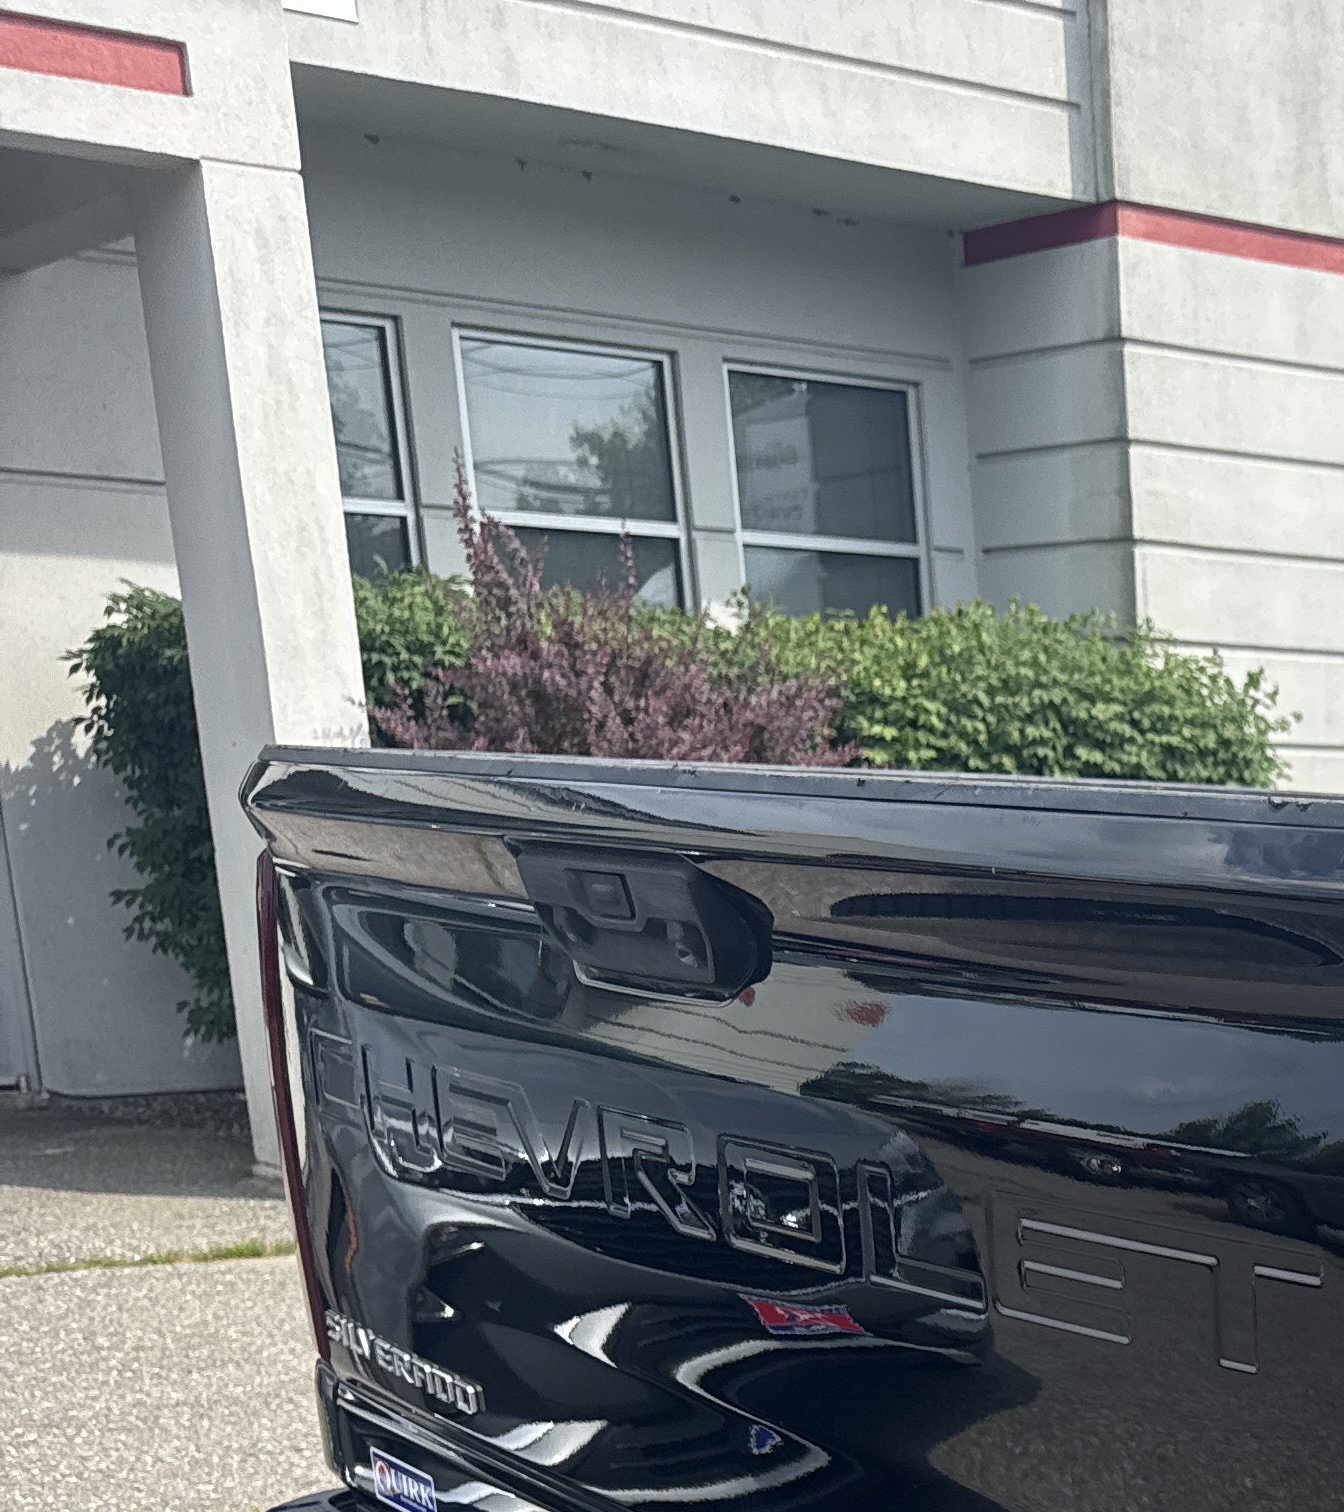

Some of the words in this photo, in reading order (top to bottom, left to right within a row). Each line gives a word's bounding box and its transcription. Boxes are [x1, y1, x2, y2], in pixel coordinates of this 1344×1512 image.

[310, 1027, 1324, 1374] CHEVROLET
[325, 1308, 483, 1416] SILVERADO
[375, 1459, 434, 1510] QUIRK
